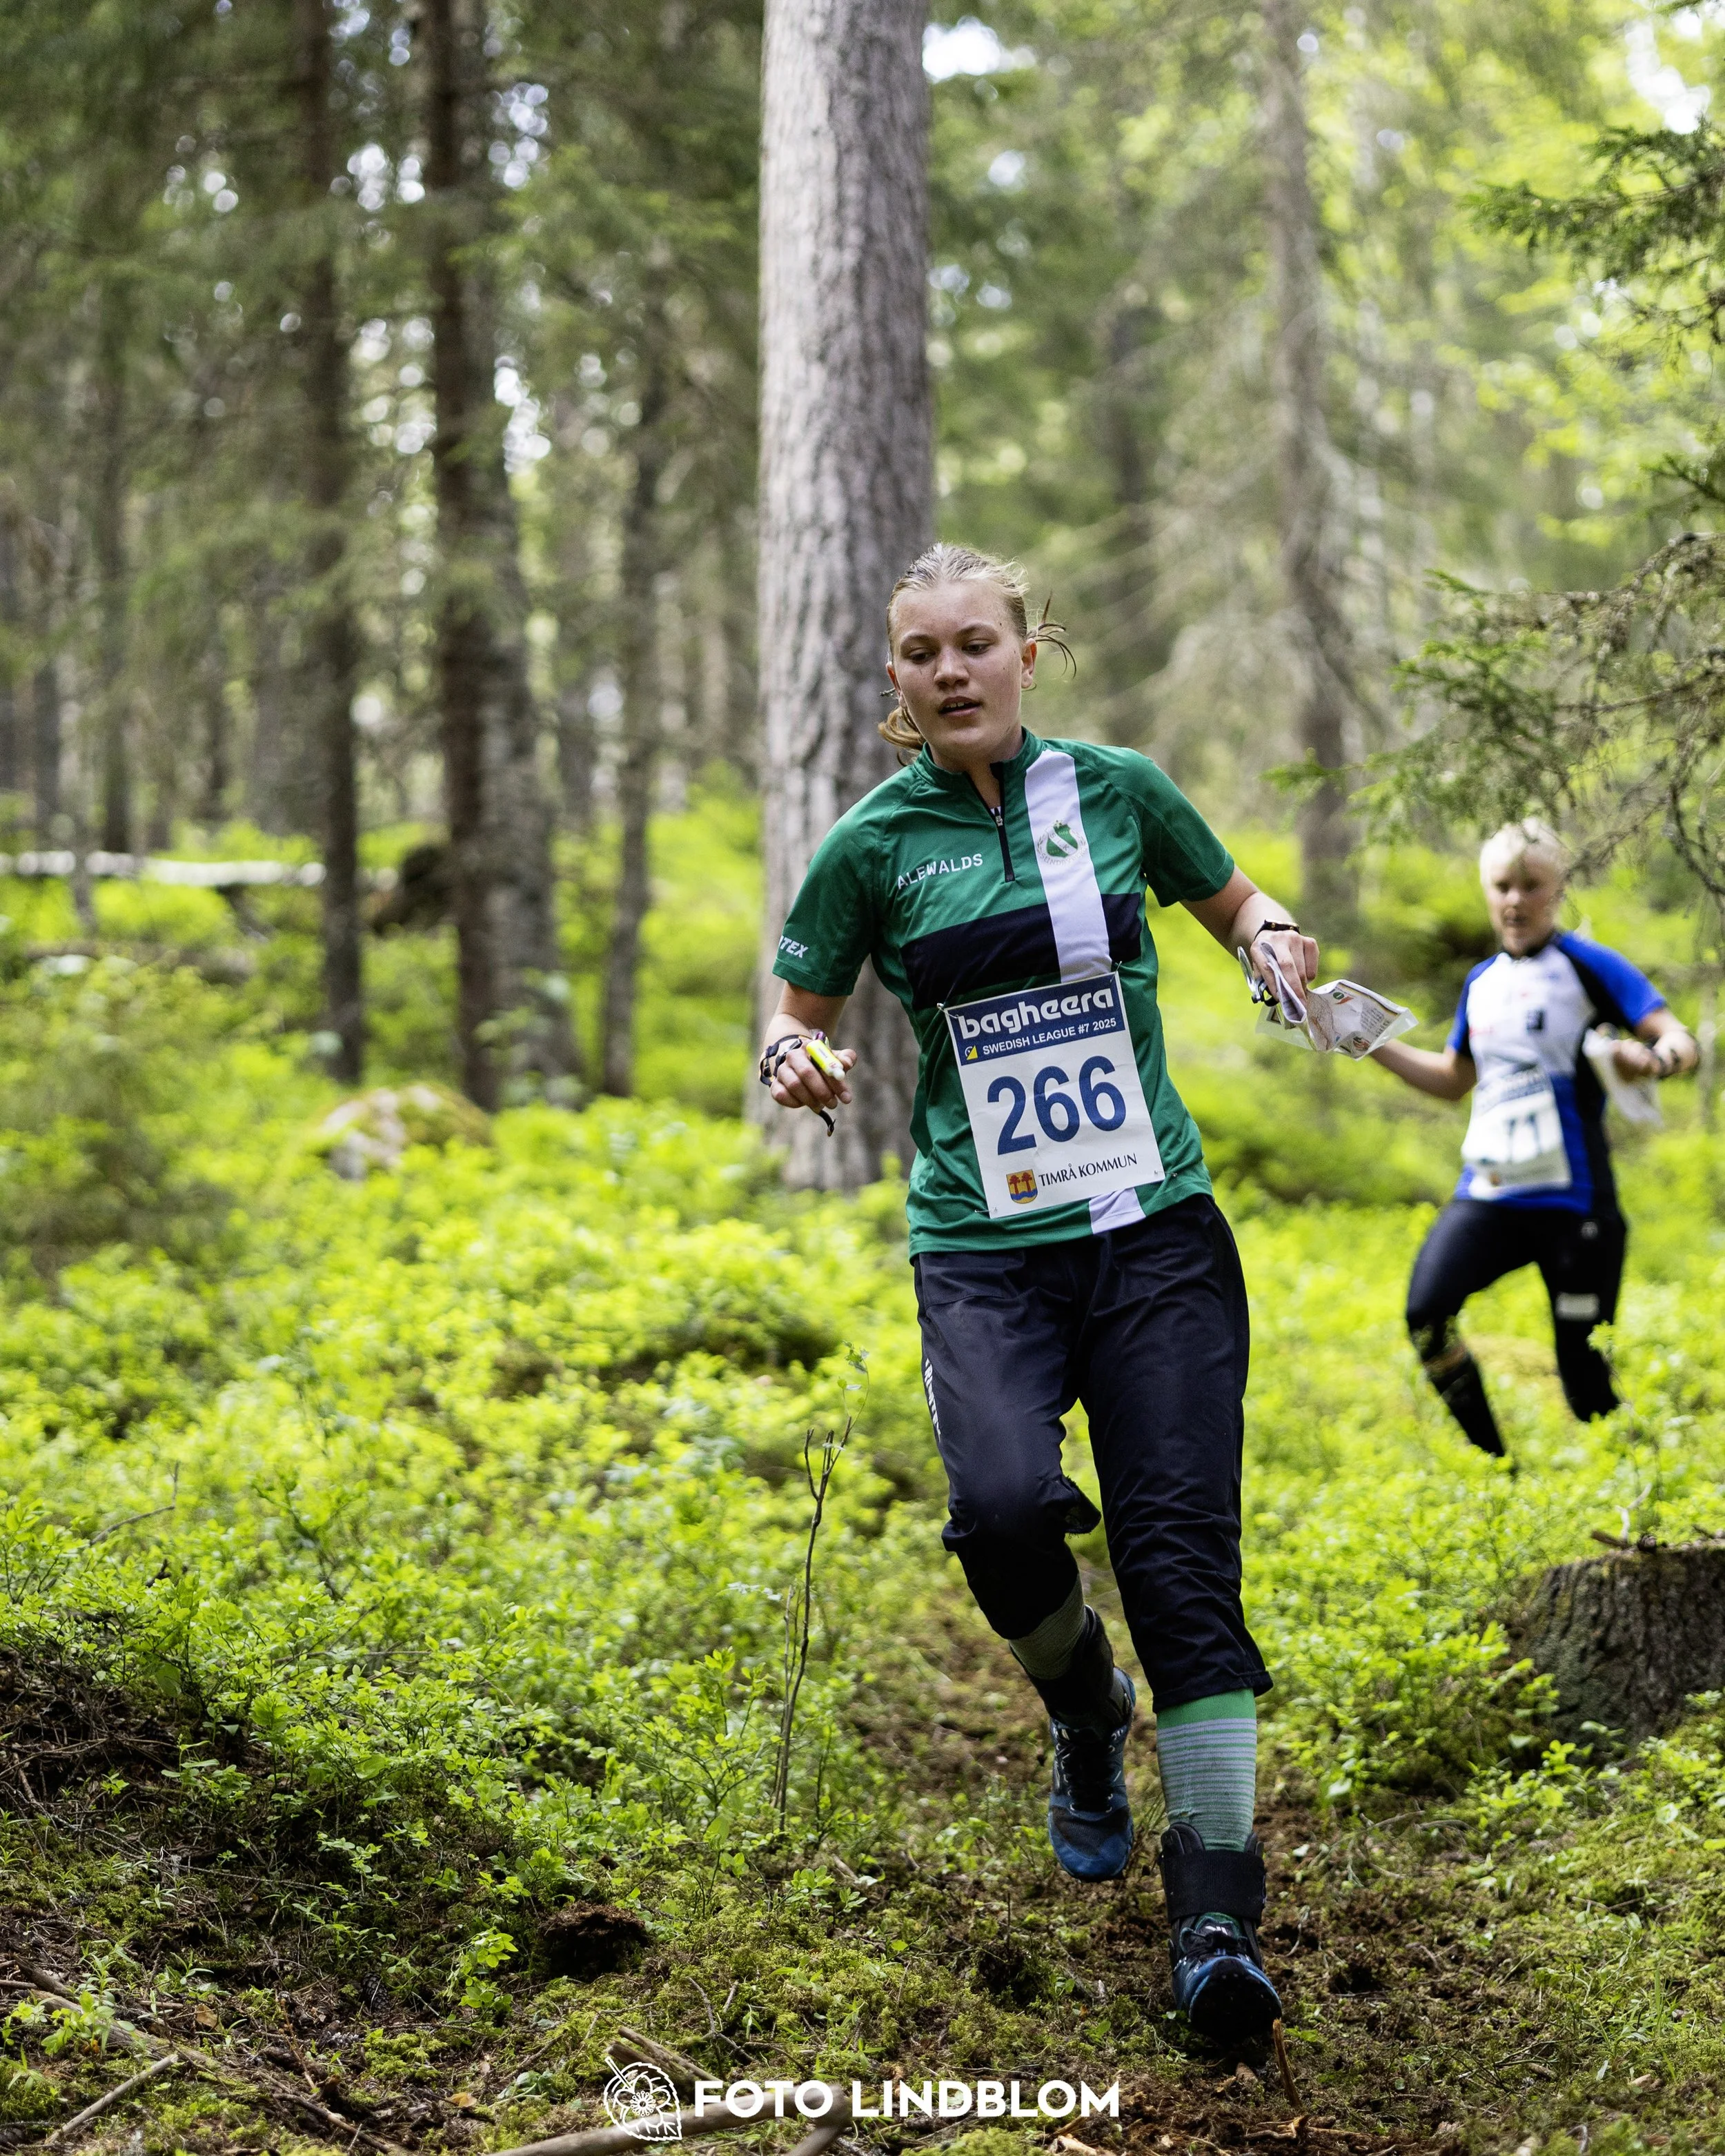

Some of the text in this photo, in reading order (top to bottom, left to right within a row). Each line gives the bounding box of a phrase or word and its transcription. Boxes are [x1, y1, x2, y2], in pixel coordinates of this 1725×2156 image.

[897, 853, 983, 890] ALEWALDS
[958, 988, 1114, 1040] bagheera
[983, 1017, 1116, 1055] SWEDISH LEAGUE #7 2025
[987, 1056, 1126, 1156] 266
[1038, 1153, 1138, 1187] TIMRÅ KOMMUN
